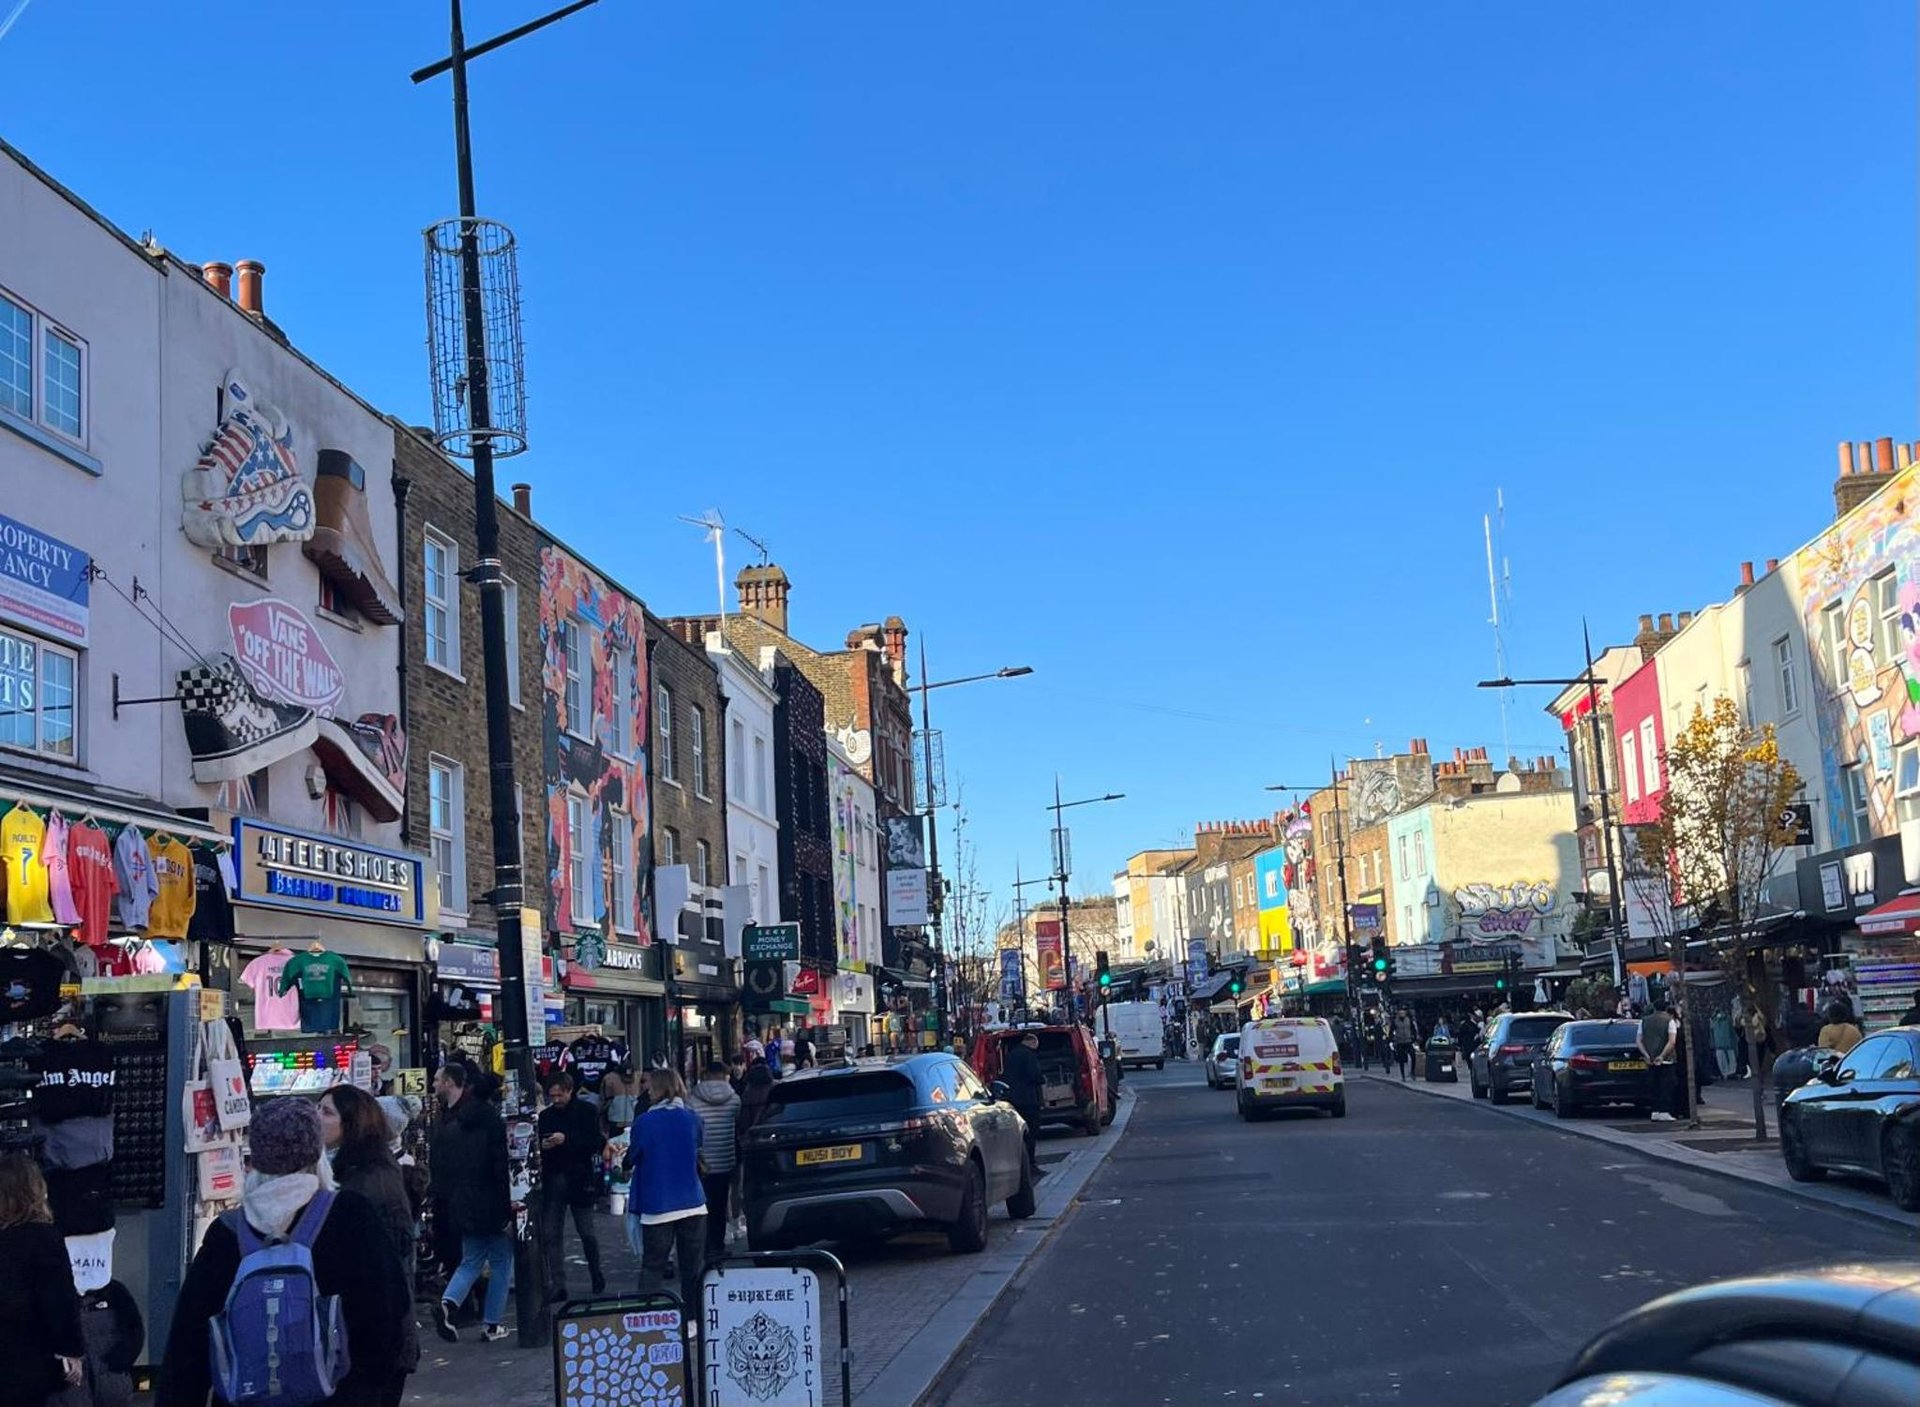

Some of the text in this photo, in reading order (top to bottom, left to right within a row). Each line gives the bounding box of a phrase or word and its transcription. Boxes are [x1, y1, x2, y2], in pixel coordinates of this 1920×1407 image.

[0, 548, 52, 588] ANCY
[267, 606, 307, 655] VANS
[272, 642, 302, 695] THE
[21, 847, 33, 885] 7
[603, 949, 642, 970] ARBUCKS
[224, 1098, 248, 1115] CAMDEN
[728, 1289, 795, 1304] SUPREME
[625, 1312, 679, 1329] TATTOOS
